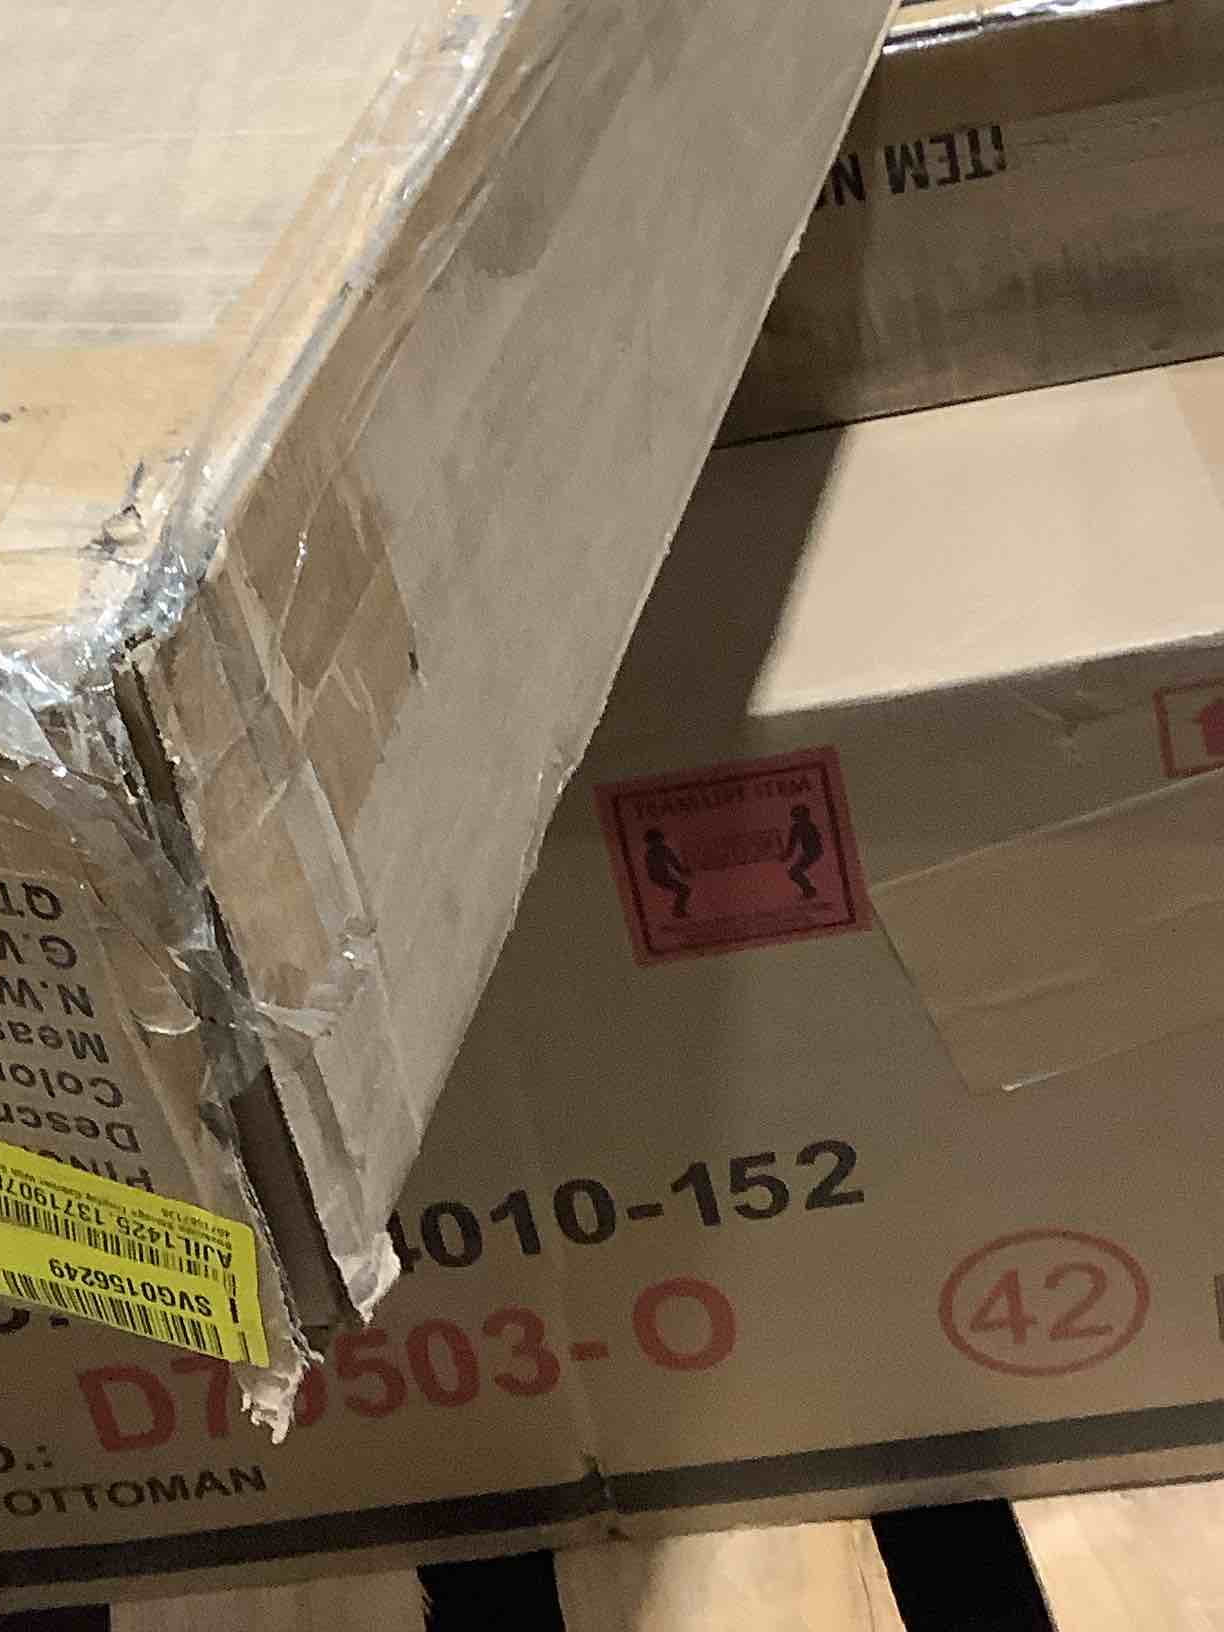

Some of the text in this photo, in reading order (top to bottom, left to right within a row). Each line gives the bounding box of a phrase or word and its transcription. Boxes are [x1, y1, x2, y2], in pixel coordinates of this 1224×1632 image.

[884, 125, 1008, 195] ITEM
[967, 1261, 1114, 1346] 42
[2, 1465, 267, 1518] OTTOMAN
